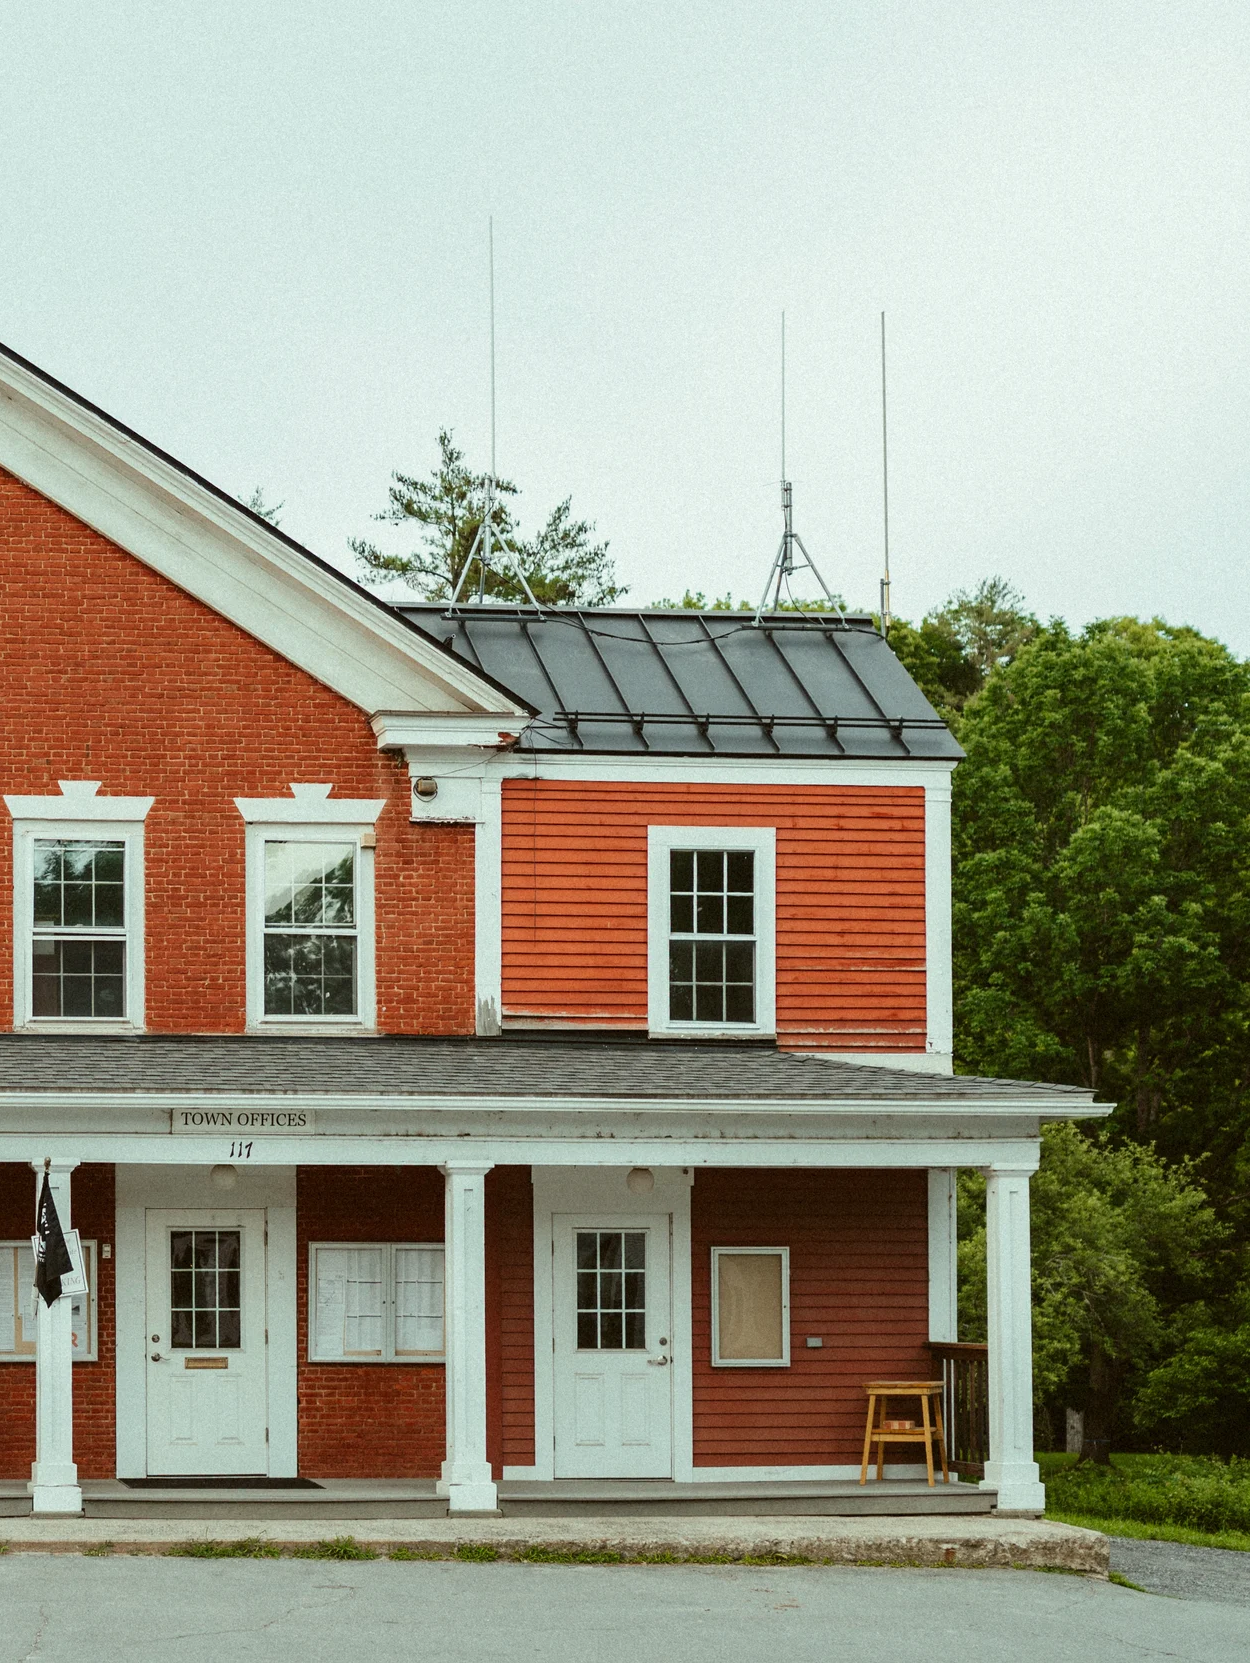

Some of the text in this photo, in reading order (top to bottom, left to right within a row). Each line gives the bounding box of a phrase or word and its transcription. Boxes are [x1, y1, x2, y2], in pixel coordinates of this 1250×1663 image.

[181, 1112, 307, 1127] TOWN OFFICES
[229, 1141, 253, 1158] 117
